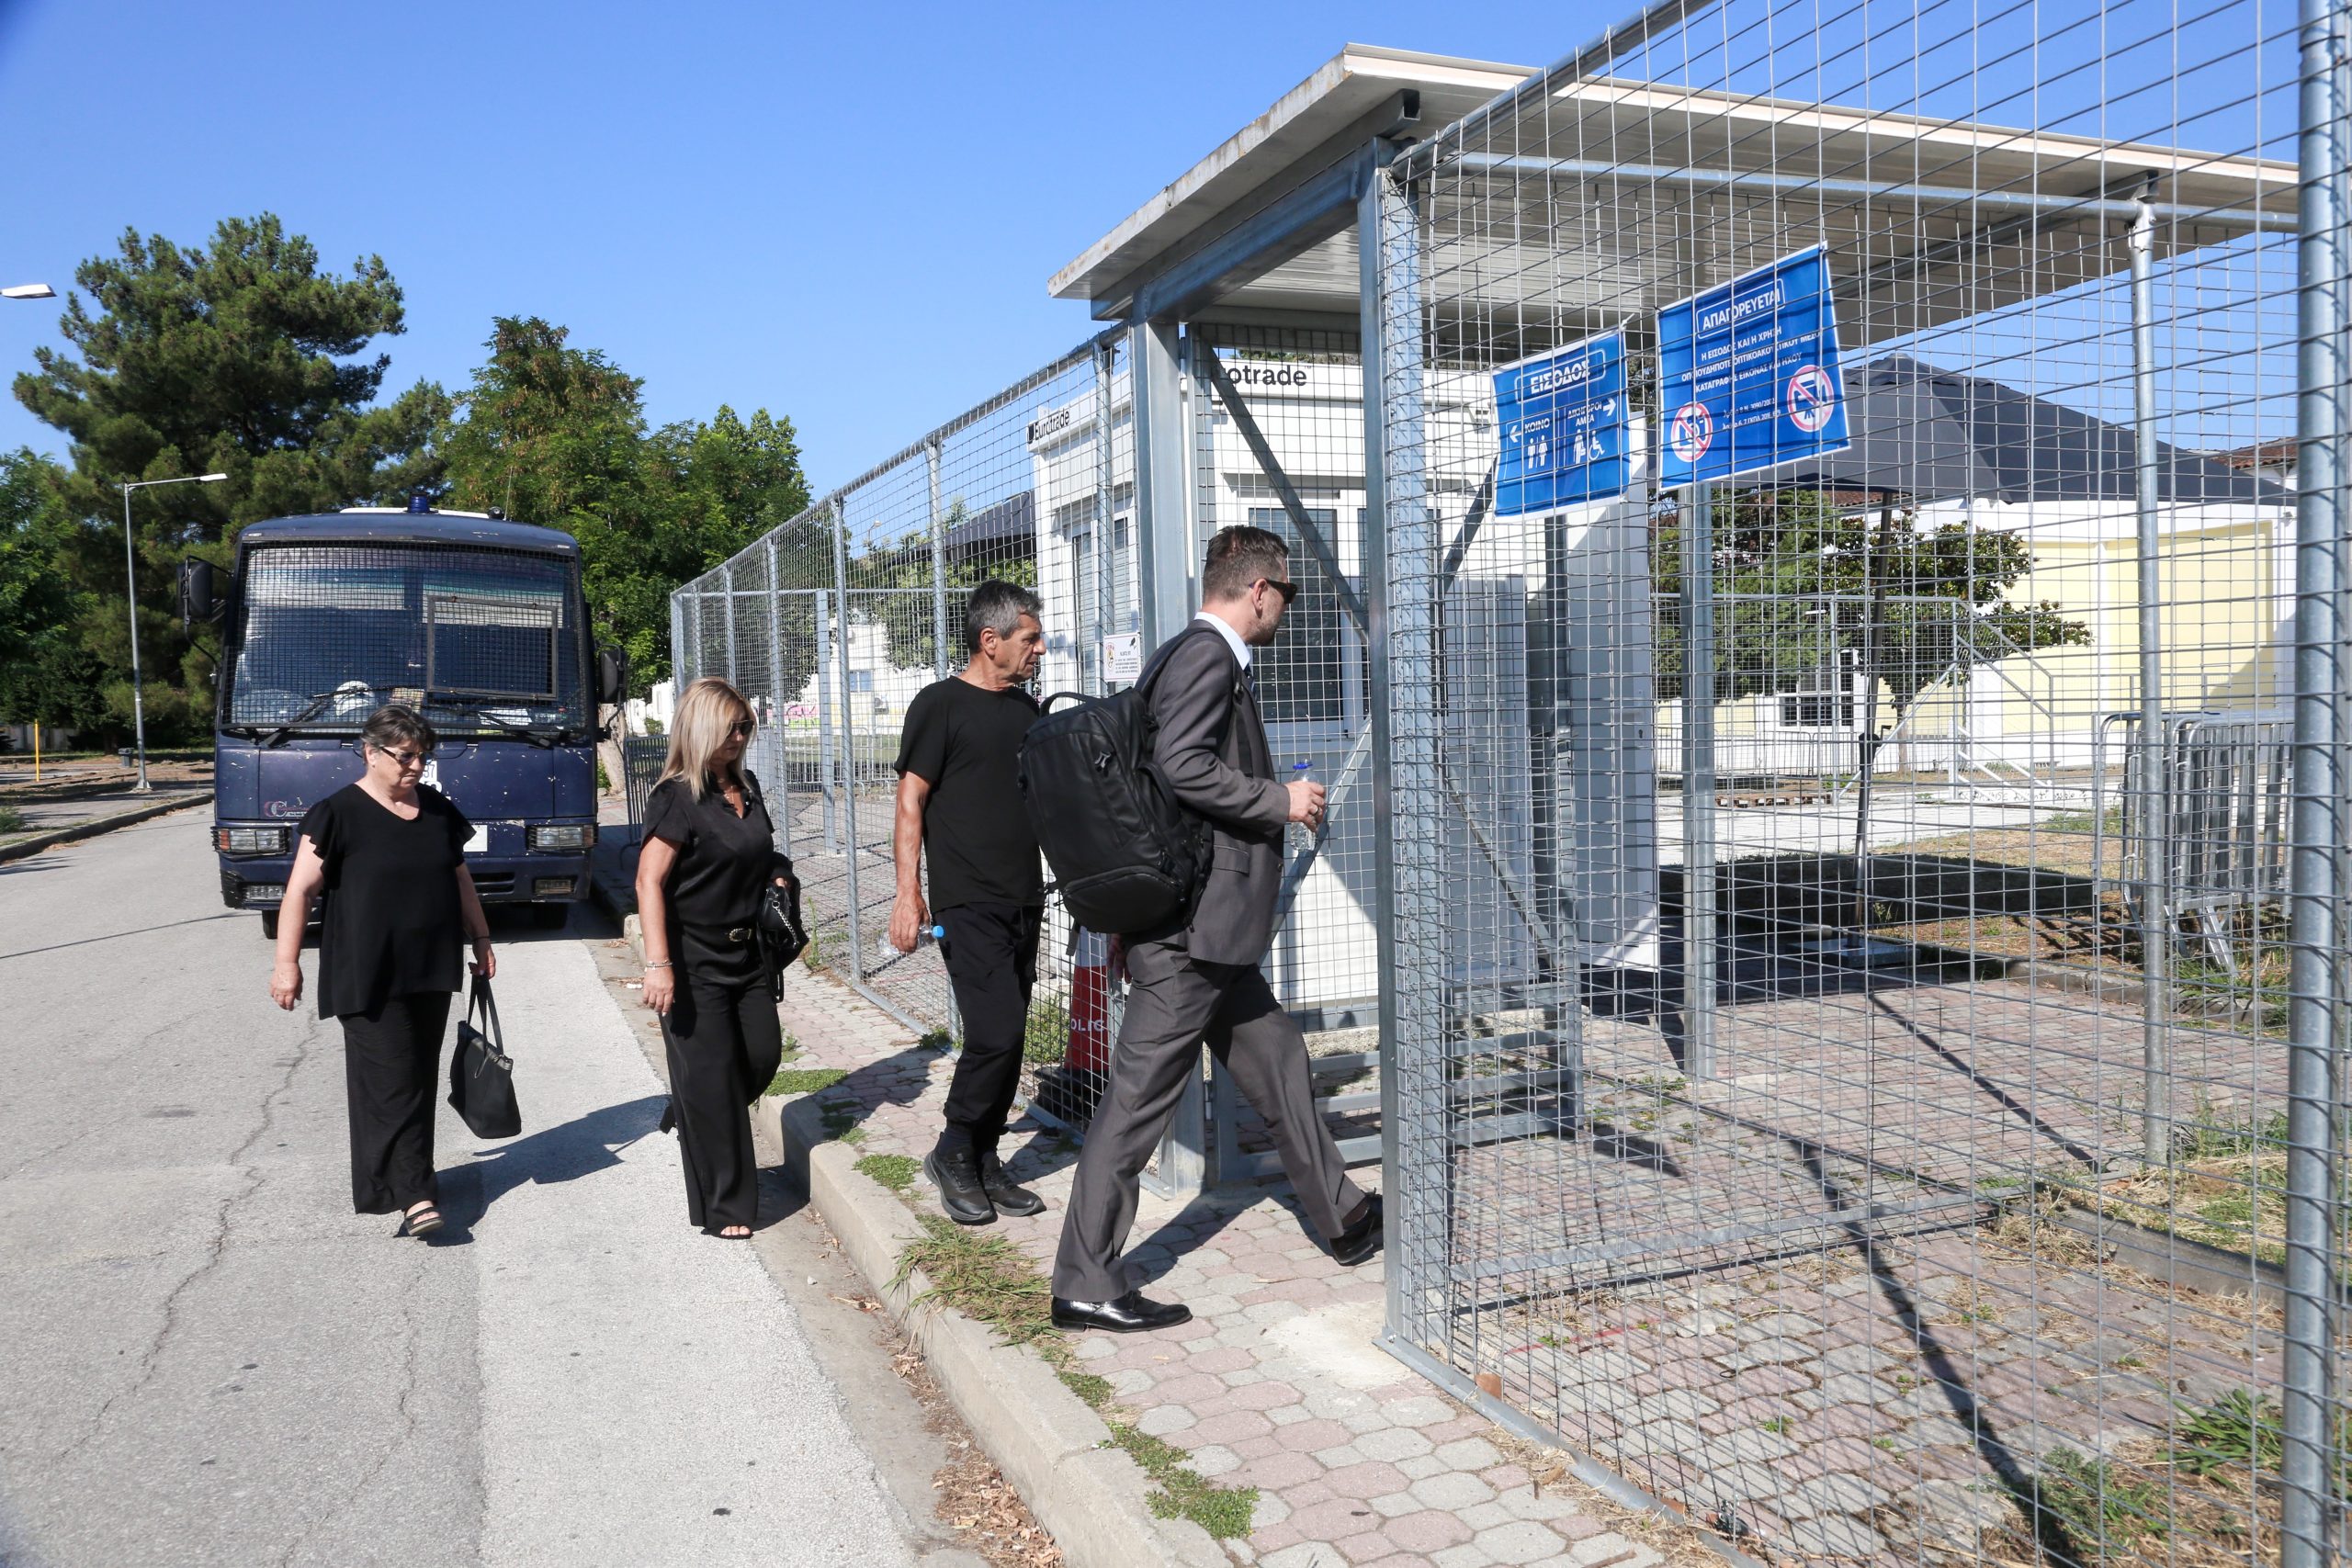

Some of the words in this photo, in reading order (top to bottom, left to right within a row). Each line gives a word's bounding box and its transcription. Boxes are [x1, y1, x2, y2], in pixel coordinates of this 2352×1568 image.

[1702, 288, 1781, 331] ΑΠΑΓΟΡΕΥΕΤΑΙ
[1737, 337, 1750, 351] ΚΑΙ
[1227, 365, 1307, 386] otrade
[1530, 359, 1591, 394] ΕΙΣΟΔΟΣ
[1035, 407, 1070, 441] Eurotrade
[1524, 418, 1551, 434] ΚΟΙΝΟ
